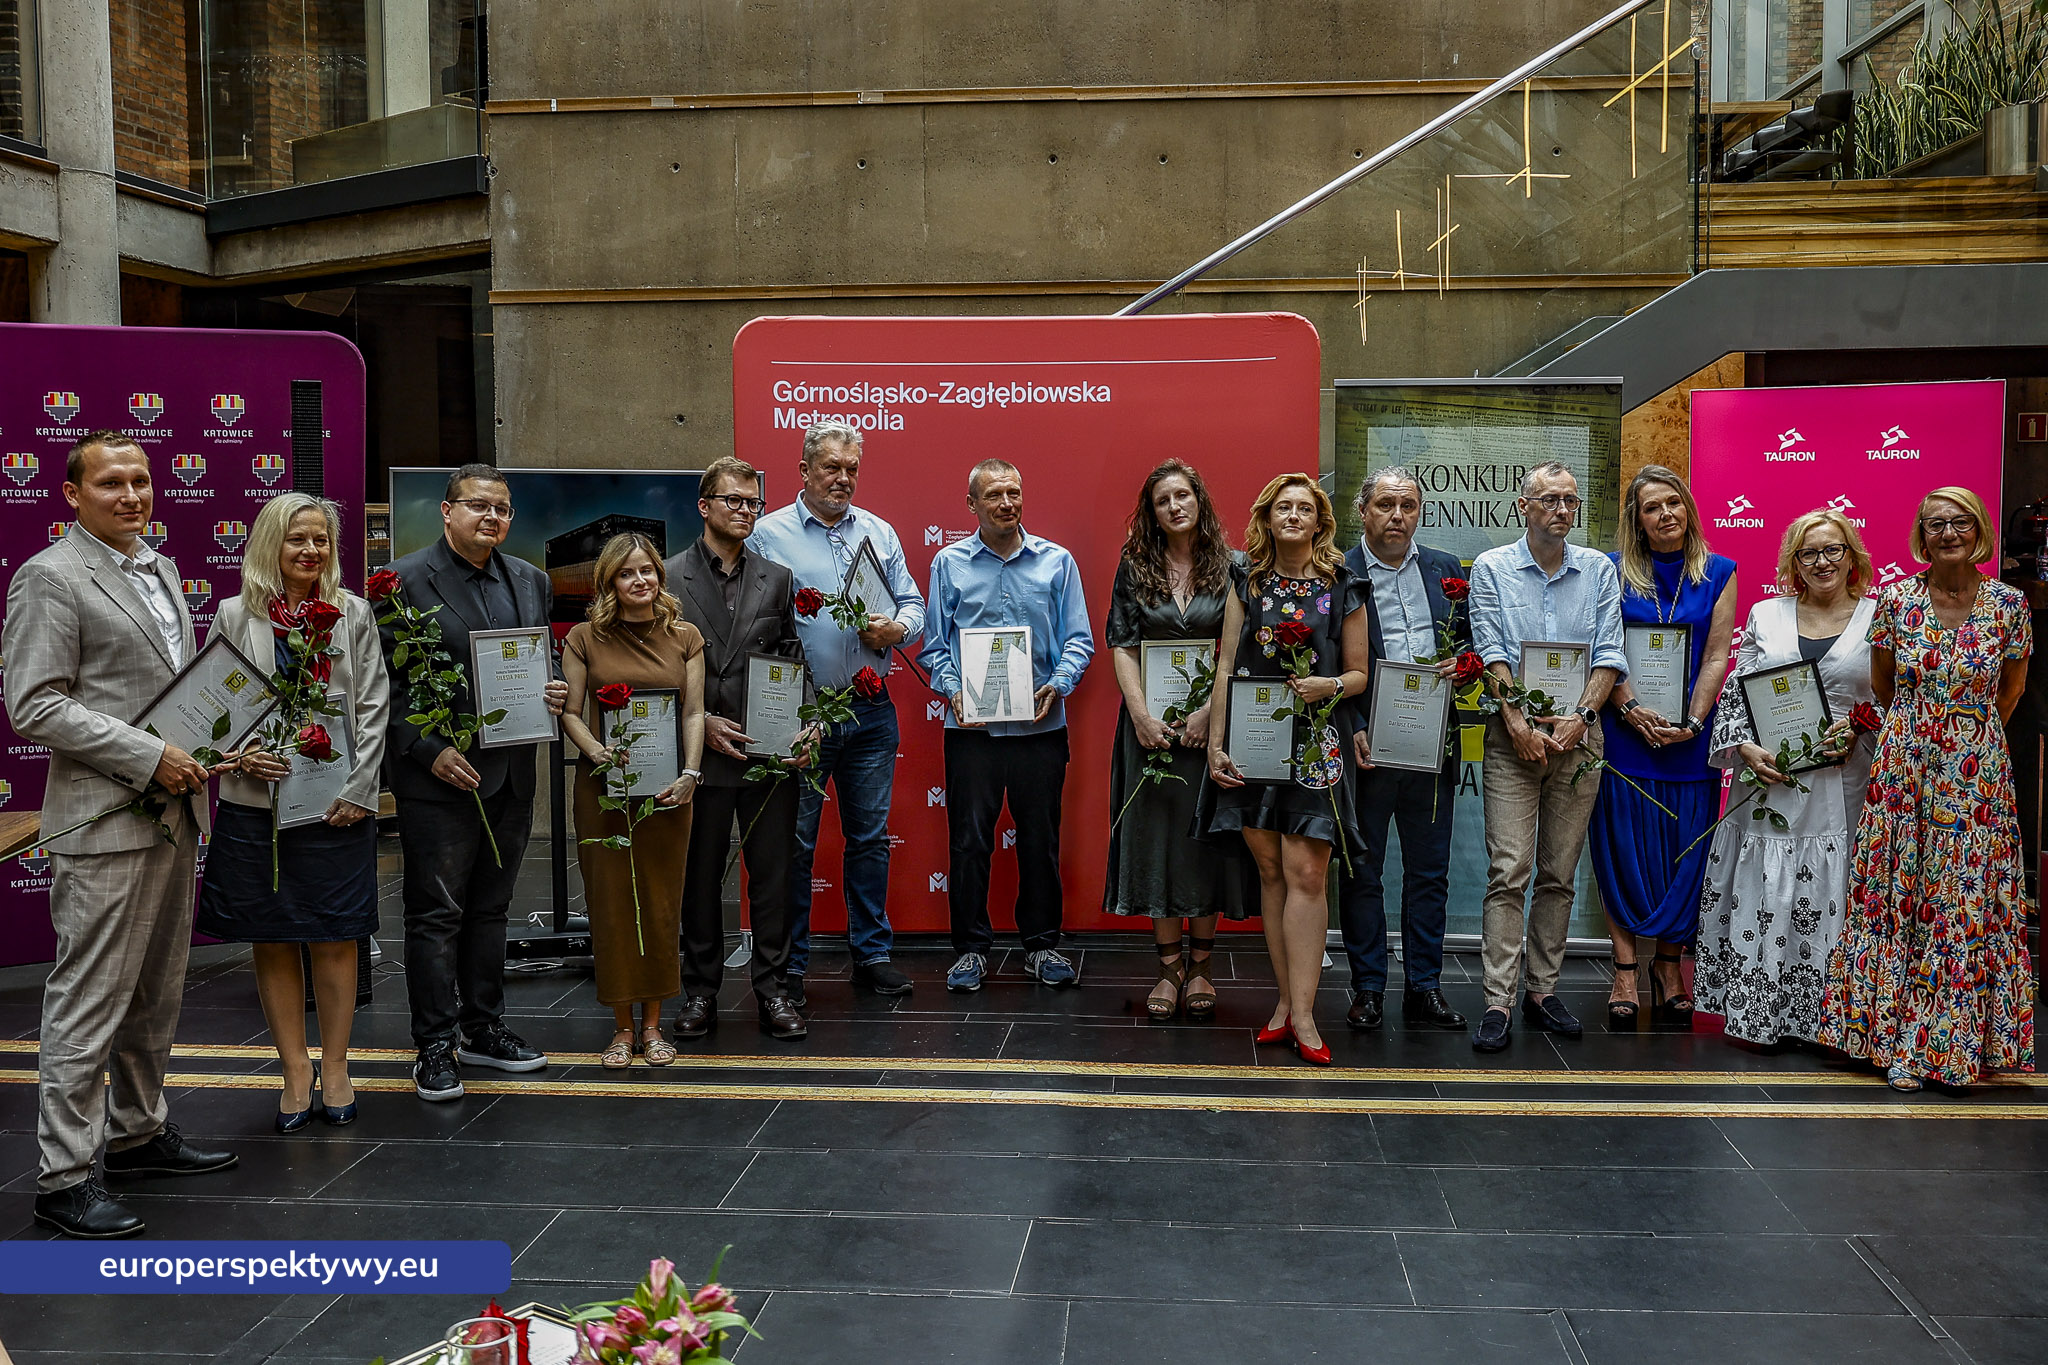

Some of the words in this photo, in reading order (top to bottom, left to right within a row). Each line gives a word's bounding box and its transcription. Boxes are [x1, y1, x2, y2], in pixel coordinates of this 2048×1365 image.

[773, 380, 1111, 409] Górnośląsko-Zagłębiowska
[35, 427, 90, 436] KATOWICE
[121, 428, 173, 437] KATOWICE
[203, 429, 254, 438] KATOWICE
[1763, 451, 1816, 462] TAURON
[1865, 449, 1920, 460] TAURON
[1416, 464, 1526, 492] KONKUR
[1, 489, 49, 497] ATOWICE
[164, 489, 215, 497] KATOWICE
[1713, 518, 1764, 528] TAURON
[206, 555, 243, 564] KATOWI
[8, 745, 48, 755] KATOWI
